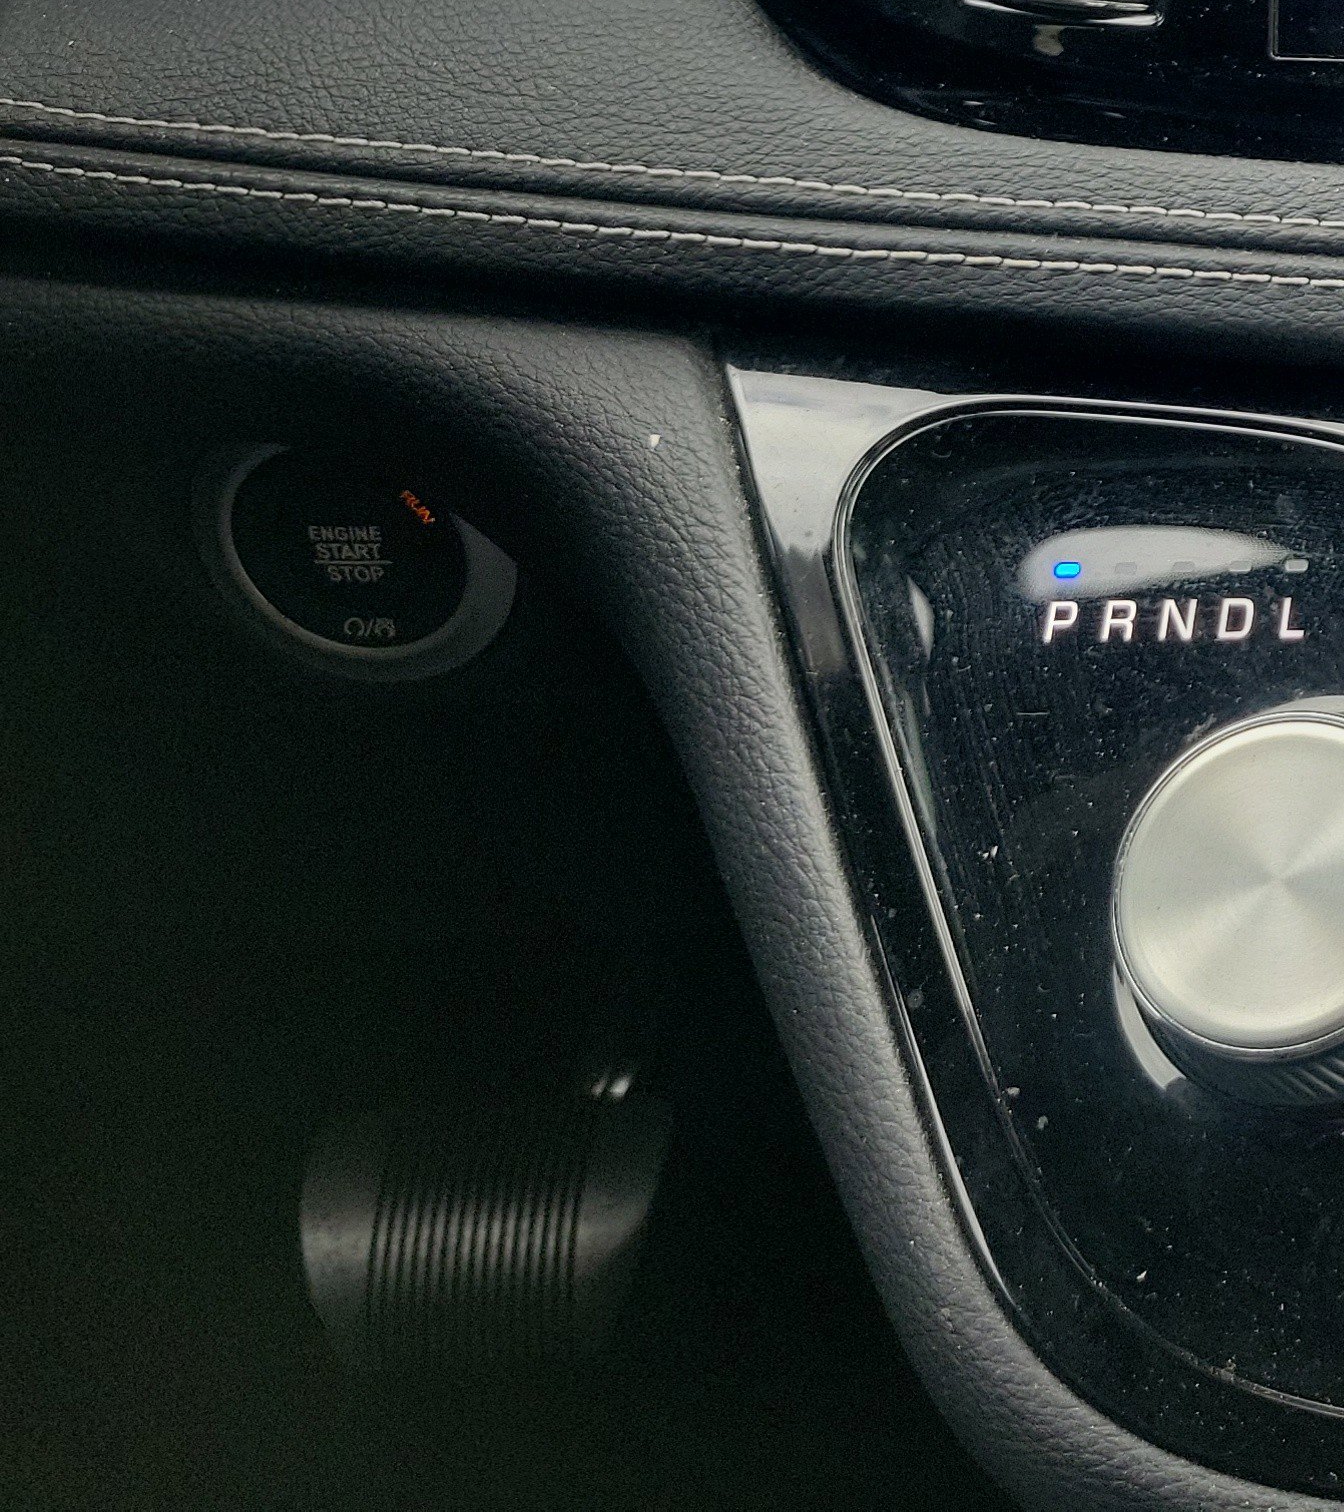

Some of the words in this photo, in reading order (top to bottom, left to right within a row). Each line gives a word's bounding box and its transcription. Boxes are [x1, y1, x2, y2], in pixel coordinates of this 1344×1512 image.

[308, 525, 382, 540] ENGINE
[316, 543, 381, 560] START
[327, 565, 385, 582] STOP
